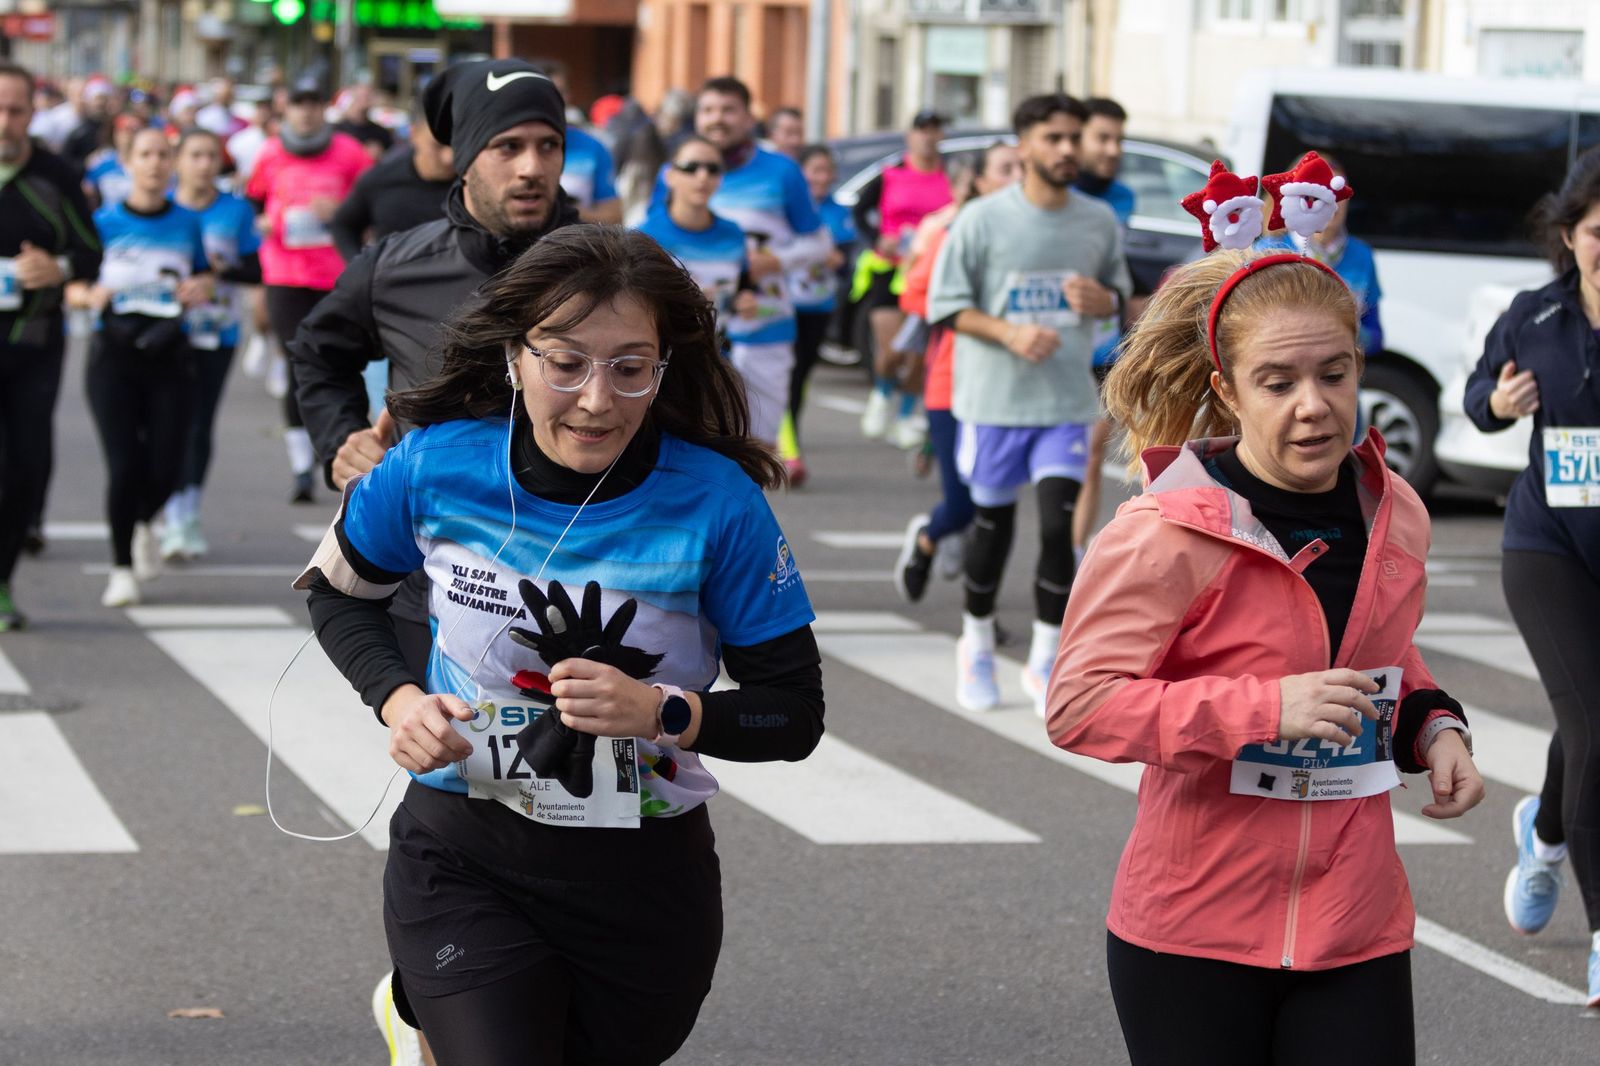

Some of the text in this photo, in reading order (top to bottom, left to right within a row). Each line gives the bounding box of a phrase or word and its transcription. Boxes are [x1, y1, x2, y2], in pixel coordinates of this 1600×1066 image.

[1572, 435, 1600, 447] SE
[451, 564, 497, 583] XLI SAN
[450, 577, 508, 601] SILVESTRE
[447, 590, 527, 620] SALMANTINA
[487, 733, 532, 780] 12
[1302, 758, 1330, 768] PILY
[529, 780, 551, 791] ALE
[1311, 777, 1353, 787] Ayuntamiento
[1310, 787, 1353, 797] de Salamanca
[536, 802, 585, 812] Ayuntamiento
[536, 811, 585, 821] de Salamanca
